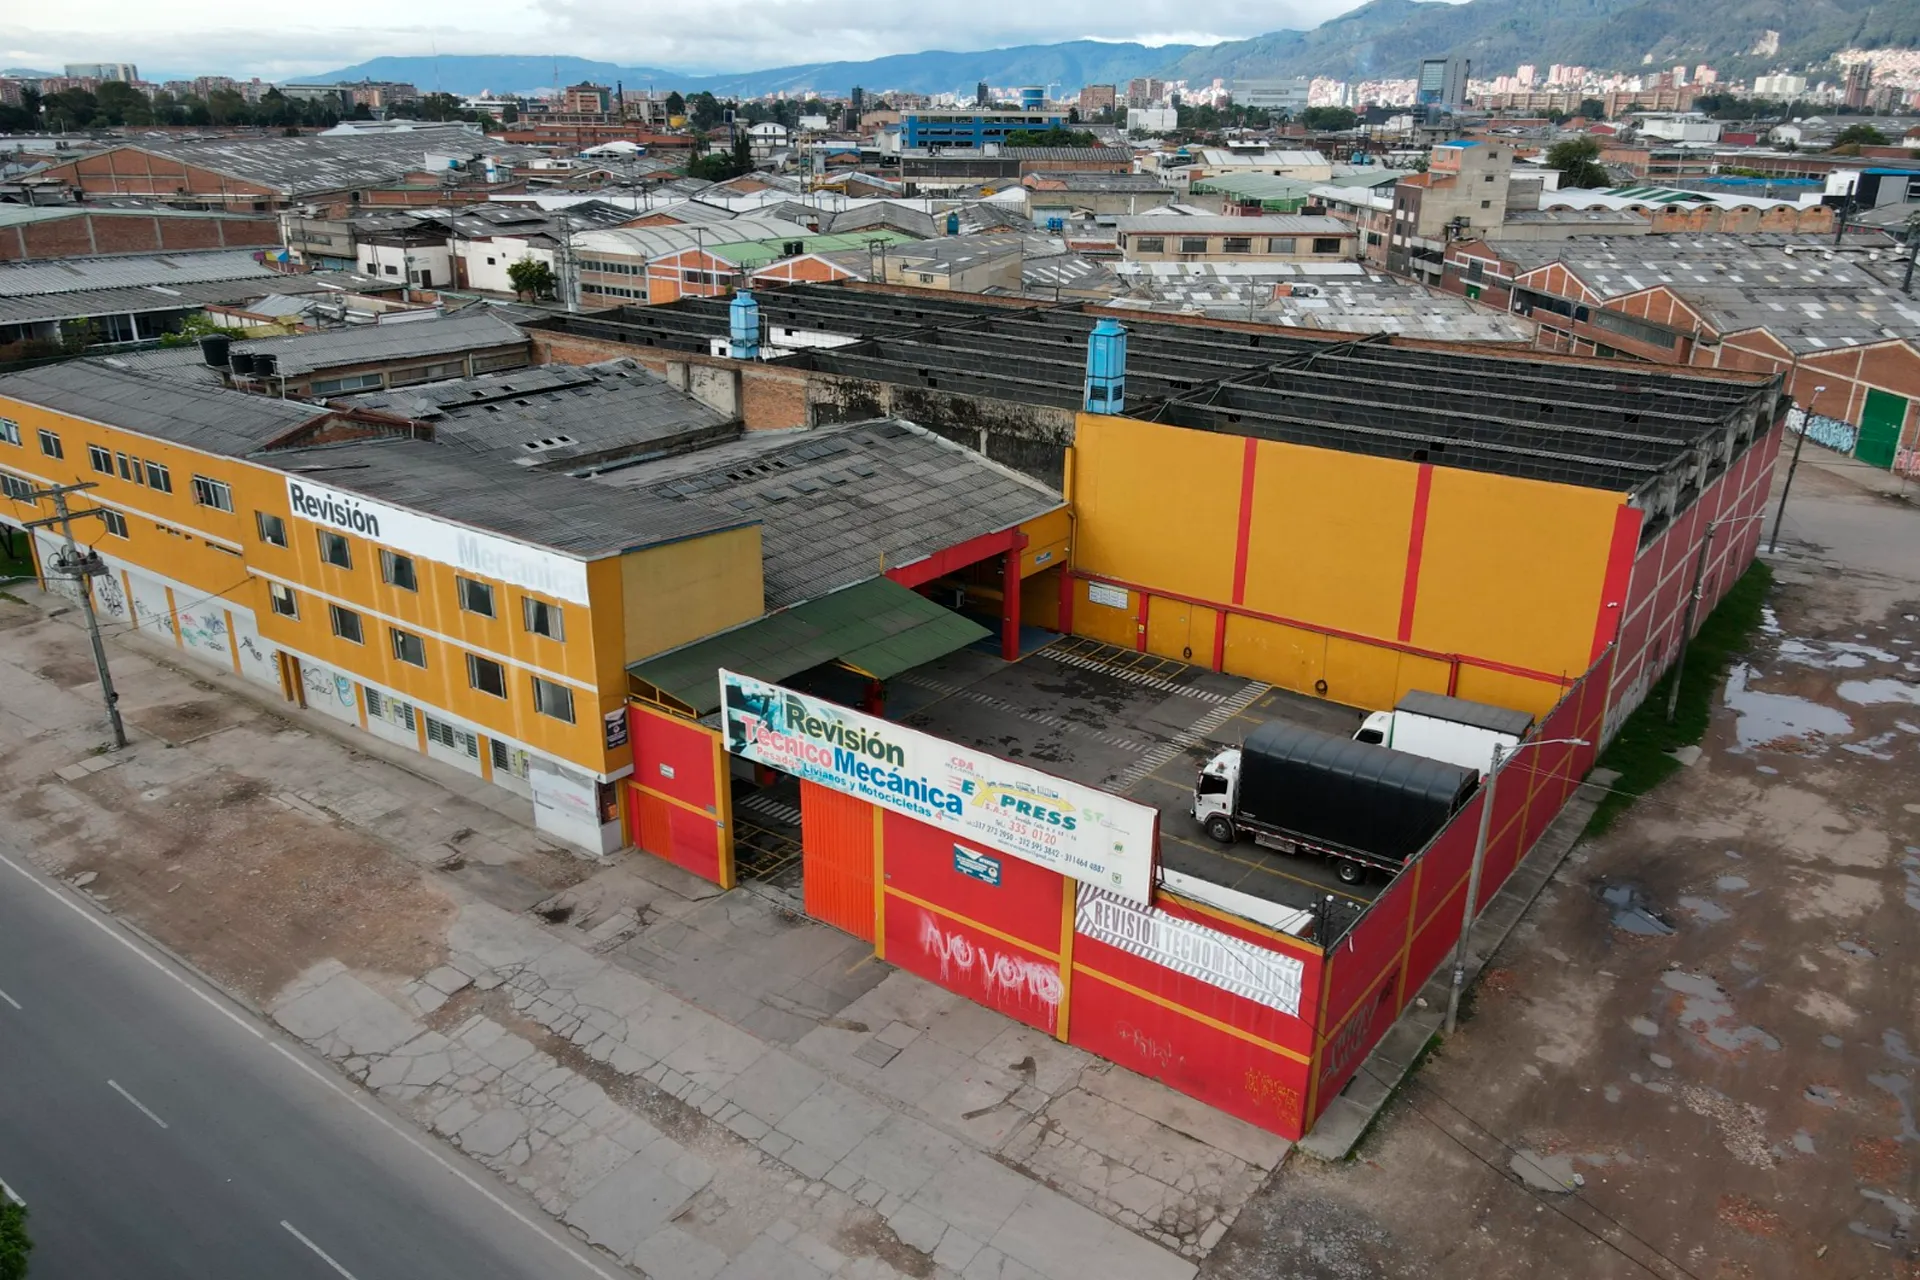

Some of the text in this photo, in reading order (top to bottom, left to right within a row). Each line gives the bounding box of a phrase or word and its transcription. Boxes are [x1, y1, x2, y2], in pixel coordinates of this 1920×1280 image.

[290, 483, 380, 537] Revisión
[786, 702, 904, 768] Revisión
[951, 757, 974, 771] CDA
[756, 746, 802, 769] Pesados
[803, 763, 847, 787] Livianos
[858, 782, 932, 818] Motocicletas
[1008, 820, 1027, 835] 335
[1031, 828, 1057, 846] 0120
[1094, 901, 1295, 1001] REVISION TECNOMECANICA
